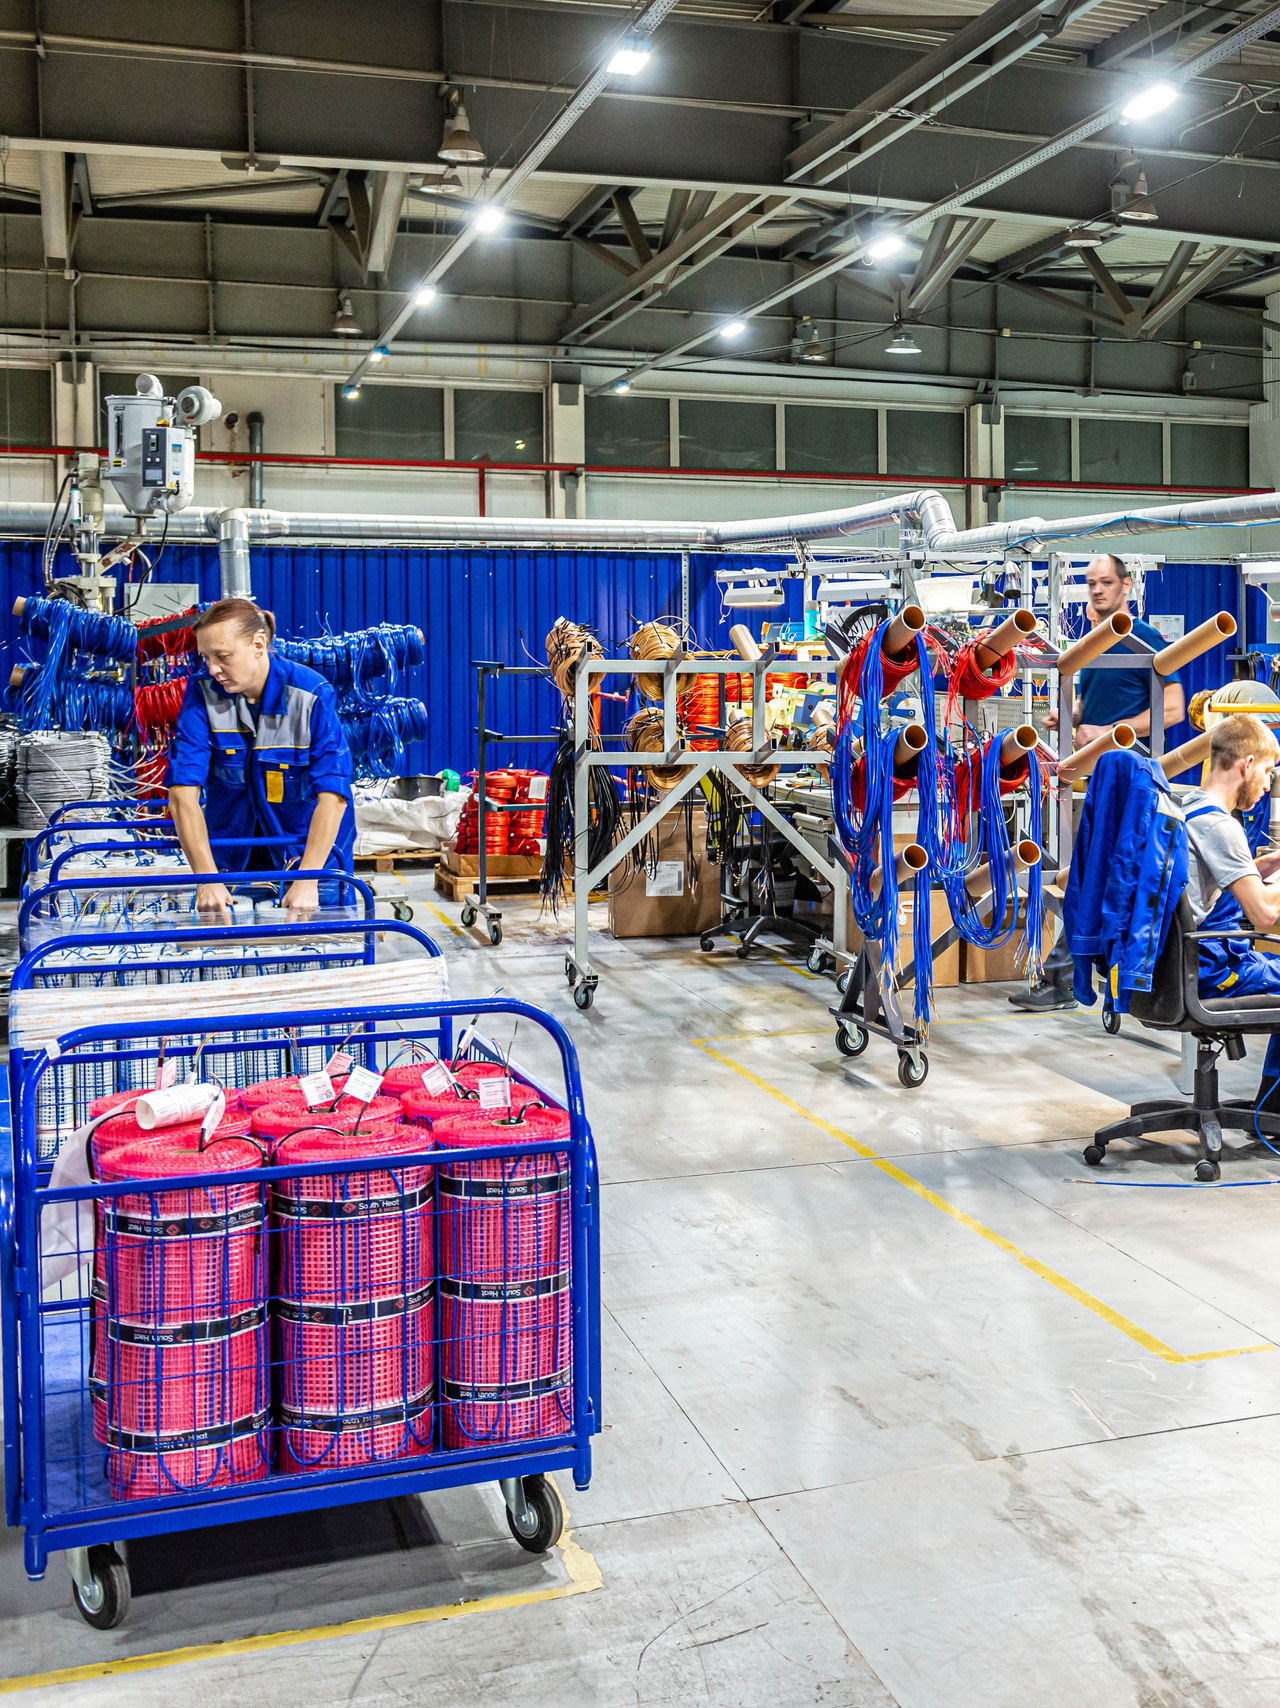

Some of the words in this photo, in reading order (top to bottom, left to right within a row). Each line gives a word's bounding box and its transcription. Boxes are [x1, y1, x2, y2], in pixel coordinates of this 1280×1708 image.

[507, 1186, 528, 1194] South
[382, 1199, 399, 1207] Heat
[238, 1209, 255, 1220] Heat
